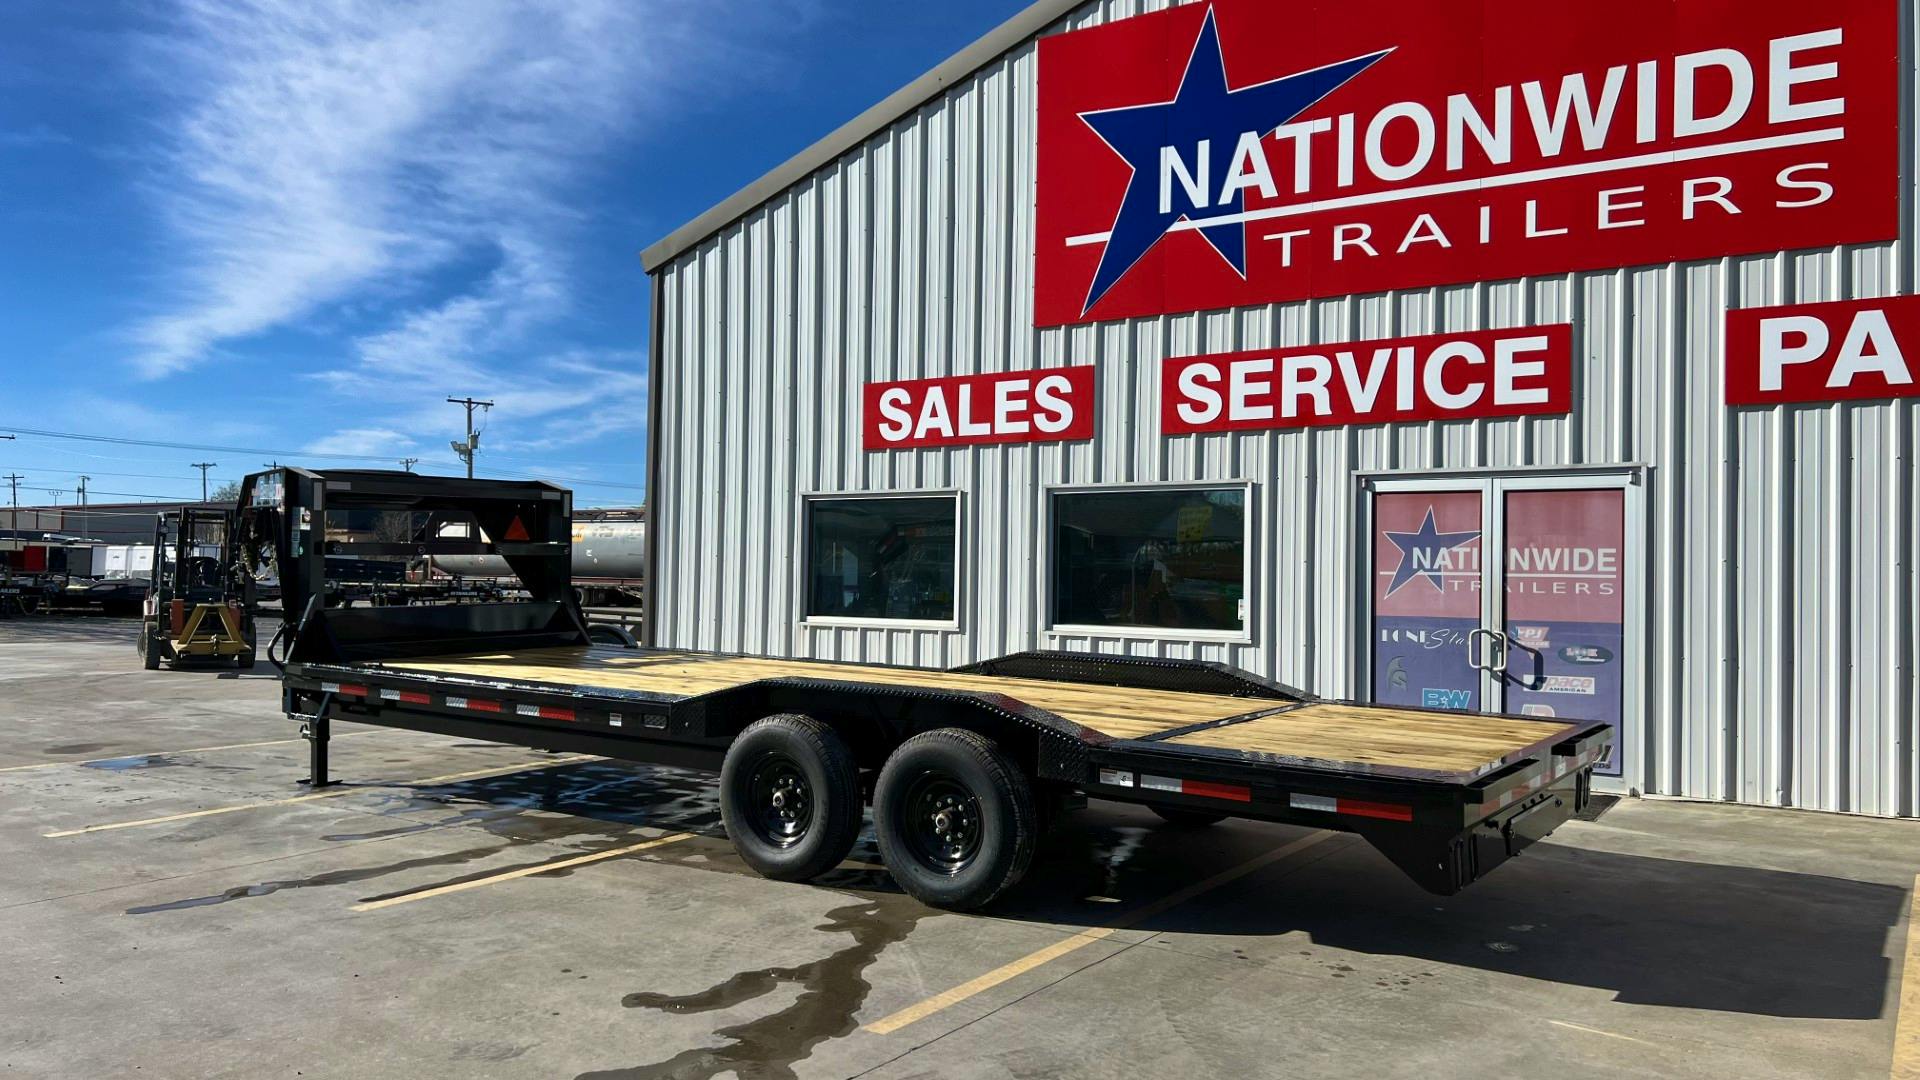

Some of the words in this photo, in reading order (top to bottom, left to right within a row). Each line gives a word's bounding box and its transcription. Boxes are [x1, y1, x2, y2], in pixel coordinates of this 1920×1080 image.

[1159, 28, 1845, 214] NATIONWIDE
[1263, 162, 1834, 267] TRAILERS
[1176, 335, 1549, 425] SERVICE
[1759, 309, 1914, 392] PA
[878, 375, 1074, 442] SALES
[1412, 546, 1617, 572] NATINWIDE
[1447, 580, 1615, 595] TRILERS
